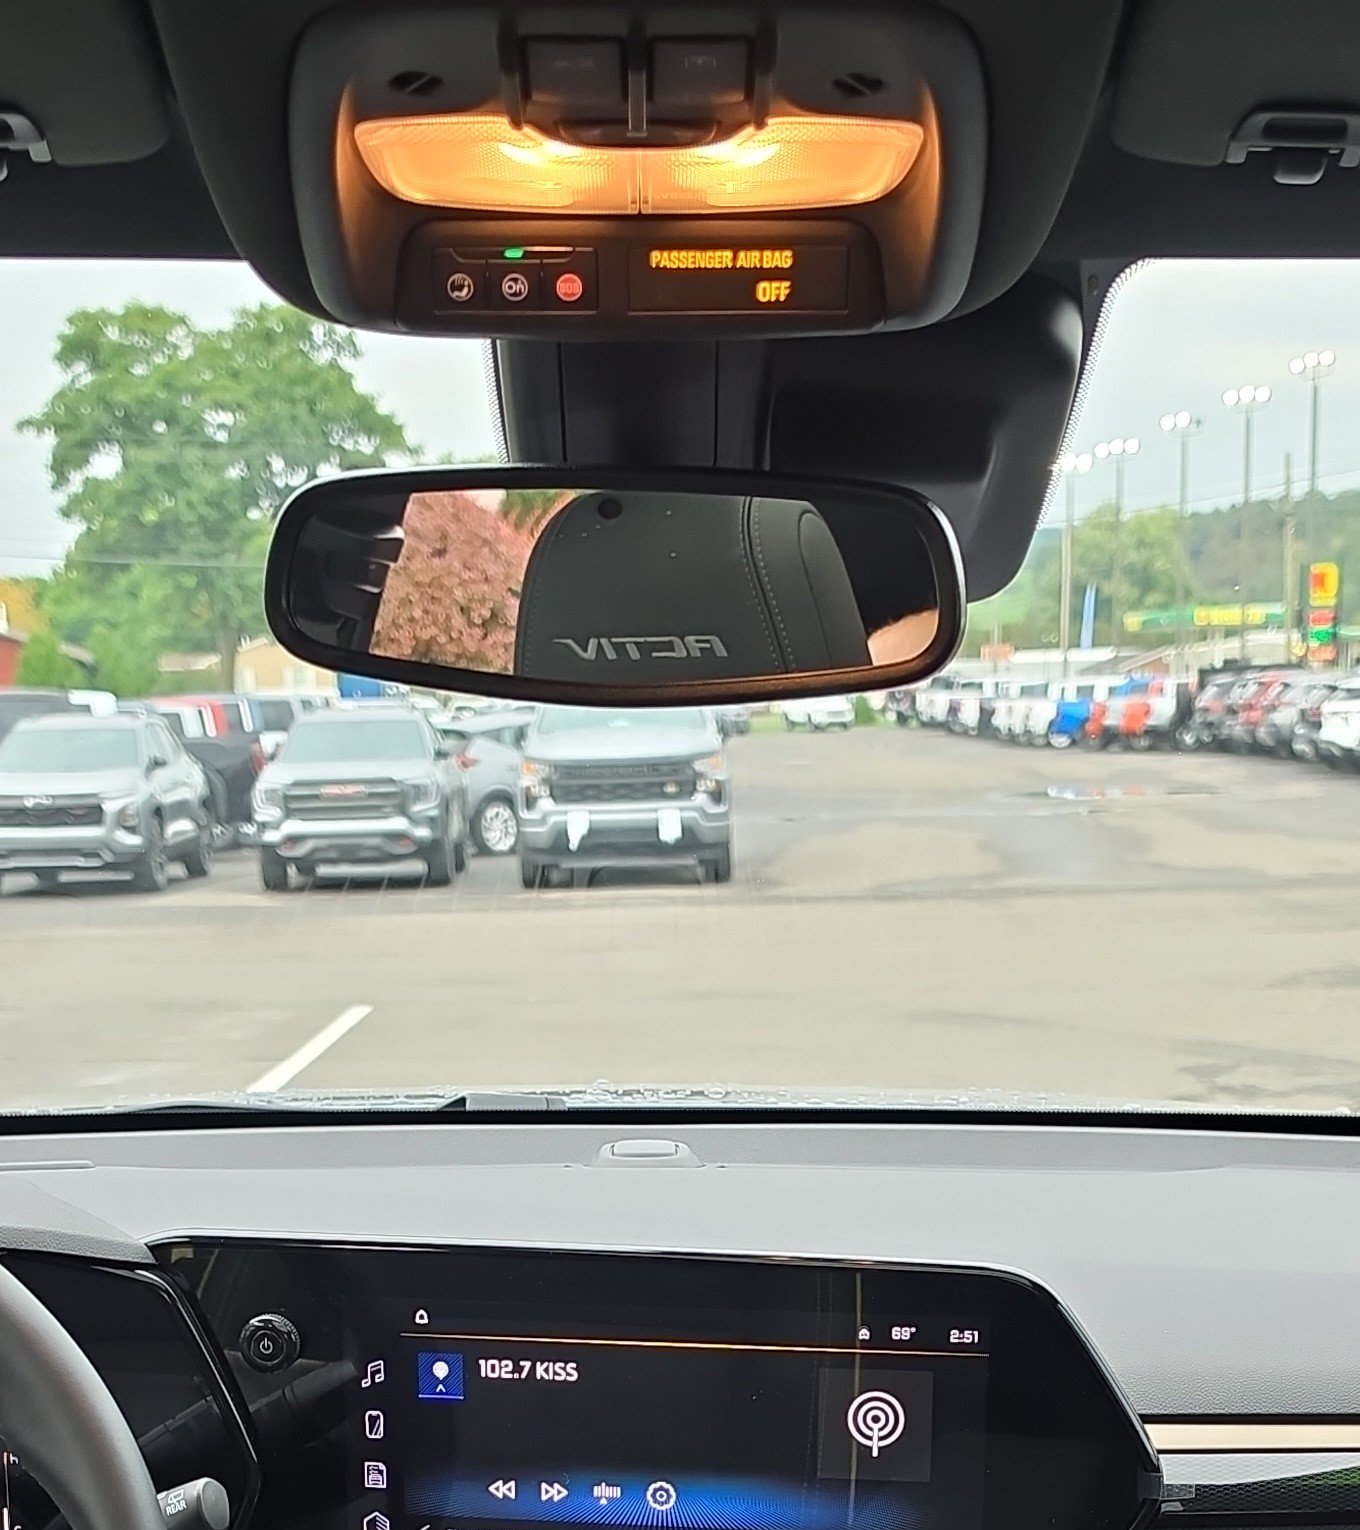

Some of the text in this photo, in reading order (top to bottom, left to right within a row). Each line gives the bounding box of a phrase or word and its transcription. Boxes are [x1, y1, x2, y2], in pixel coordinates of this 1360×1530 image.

[650, 250, 793, 269] PASSENGER AIR BAG
[756, 280, 791, 302] OFF
[891, 1326, 916, 1340] 69°
[949, 1329, 979, 1344] 2:51
[478, 1359, 578, 1382] 102.7 KISS
[165, 1500, 187, 1516] REAR
